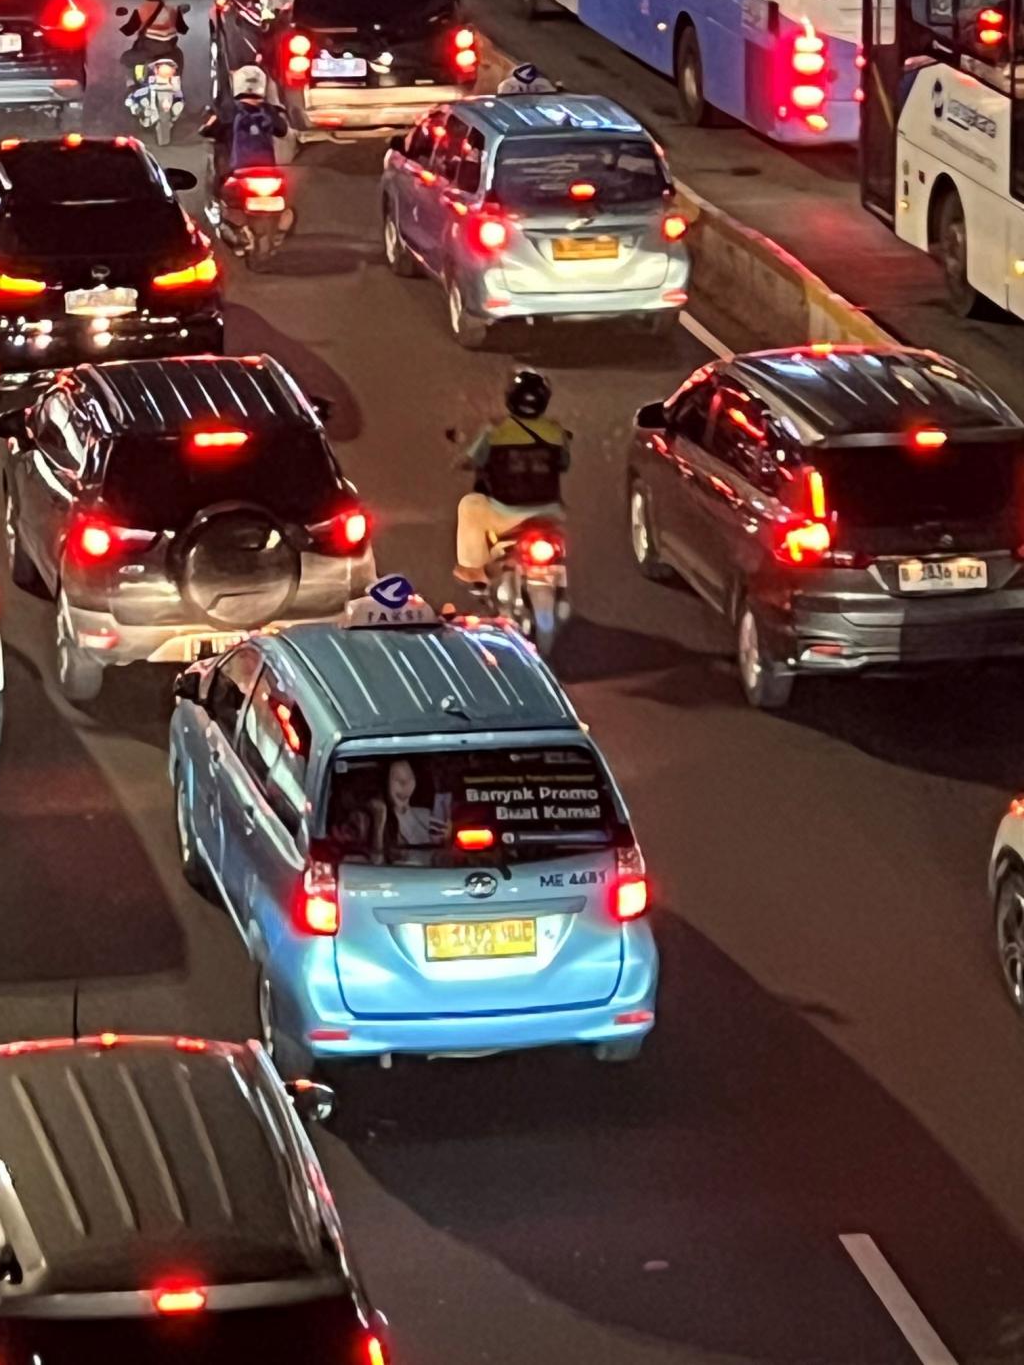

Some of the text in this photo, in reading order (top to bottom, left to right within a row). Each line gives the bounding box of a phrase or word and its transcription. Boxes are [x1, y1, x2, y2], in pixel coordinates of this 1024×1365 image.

[465, 786, 599, 803] Banyak Promo
[496, 806, 539, 820] Buat
